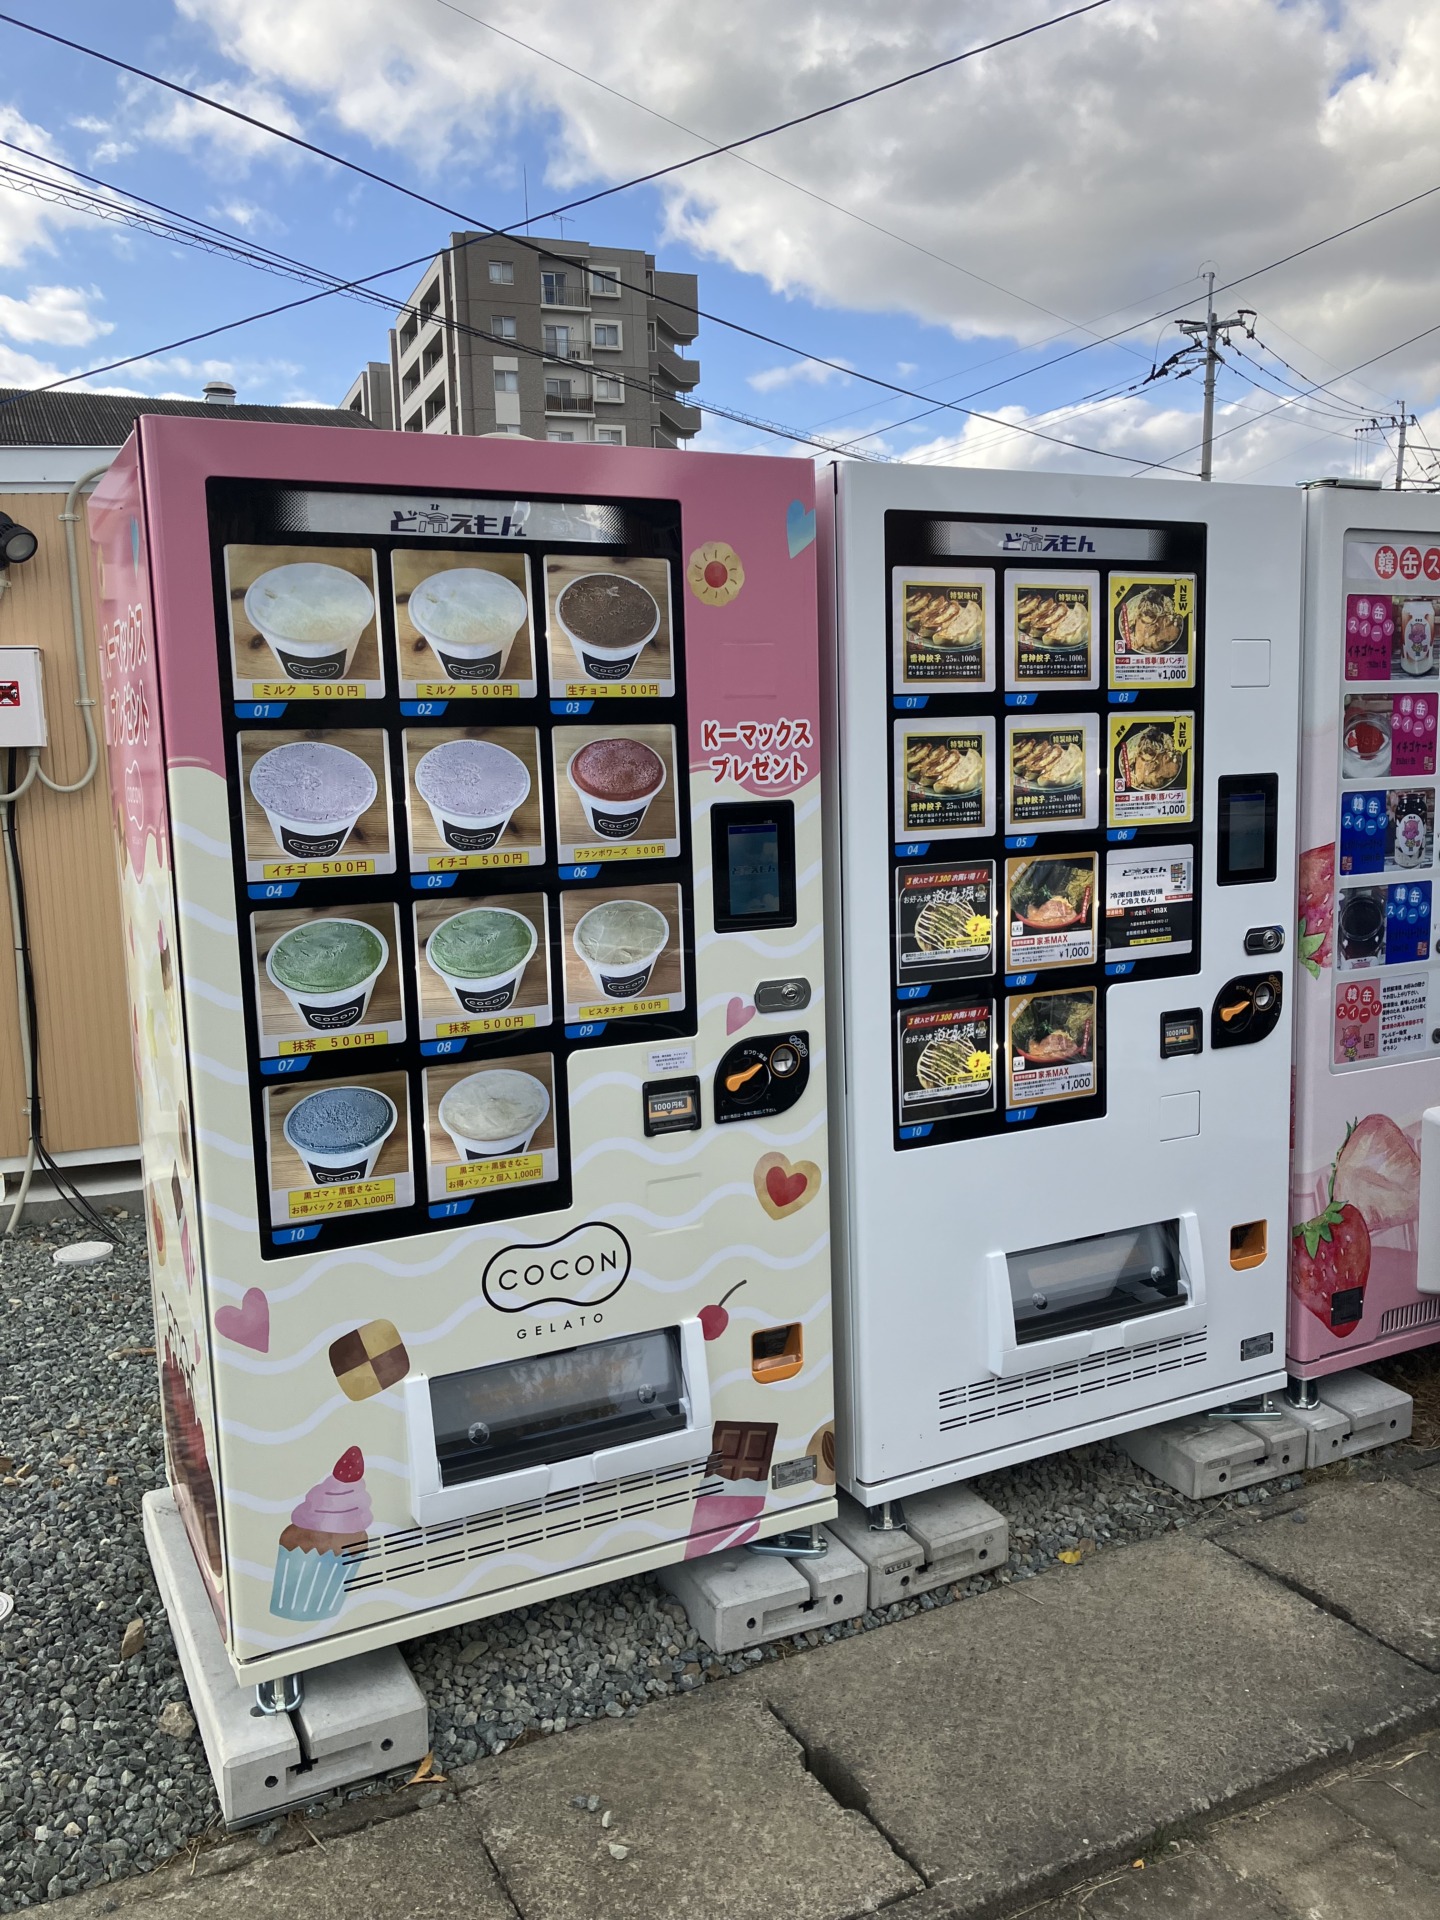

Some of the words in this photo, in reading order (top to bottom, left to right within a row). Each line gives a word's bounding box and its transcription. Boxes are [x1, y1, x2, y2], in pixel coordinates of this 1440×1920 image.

[1002, 532, 1096, 553] ど冷えもん
[1179, 585, 1188, 611] NEW
[1349, 620, 1393, 635] スイーツ
[292, 667, 335, 676] COCON
[453, 667, 490, 675] COCON
[593, 666, 628, 675] COCON
[1158, 669, 1187, 681] ¥1,000
[263, 685, 297, 696] ミルク
[312, 685, 358, 697] 500円
[426, 685, 456, 696] ミルク
[471, 684, 513, 696] 500円
[567, 685, 608, 696] 生チョコ
[620, 684, 659, 696] 500円
[906, 697, 918, 708] 01
[1016, 694, 1028, 705] 02
[1118, 692, 1129, 702] 03
[253, 704, 270, 717] 01
[416, 703, 433, 715] 02
[565, 702, 580, 713] 03
[1392, 716, 1434, 730] スイーツ
[1178, 721, 1187, 748] NEW
[711, 754, 806, 784] プレゼント
[1157, 804, 1186, 816] ¥1,000
[602, 821, 635, 830] COCON
[1343, 815, 1387, 831] スイーツ
[454, 835, 492, 844] COCON
[1116, 829, 1128, 840] 06
[293, 841, 335, 852] COCON
[1016, 837, 1028, 848] 05
[575, 848, 628, 859] フランボワーズ
[636, 846, 664, 855] 500円
[907, 844, 919, 855] 04
[436, 857, 469, 868] イチゴ
[481, 854, 523, 865] 500円
[272, 863, 308, 876] イチゴ
[322, 861, 368, 874] 500円
[573, 866, 587, 878] 06
[427, 875, 442, 887] 05
[266, 885, 283, 897] 04
[1110, 888, 1164, 899] 冷凍自動販売機
[1386, 905, 1428, 919] スイーツ
[1036, 934, 1068, 946] 家系MAX
[1059, 946, 1089, 959] ¥1,000
[1116, 963, 1126, 974] 09
[611, 981, 643, 990] COCON
[1016, 974, 1027, 986] 08
[908, 987, 920, 998] 07
[470, 996, 506, 1006] COCON
[588, 1005, 625, 1016] ピスタチオ
[633, 1001, 662, 1011] 600円
[1338, 1003, 1380, 1018] スイーツ
[315, 1011, 355, 1021] COCON
[449, 1021, 471, 1034] 抹茶
[483, 1016, 524, 1030] 500円
[579, 1024, 594, 1036] 09
[292, 1040, 317, 1053] 抹茶
[330, 1033, 375, 1048] 500円
[436, 1041, 452, 1053] 08
[277, 1059, 295, 1072] 07
[1037, 1067, 1070, 1079] 家系MAX
[1060, 1077, 1091, 1091] ¥1,000
[653, 1100, 685, 1112] 1000円札
[1016, 1109, 1027, 1120] 11
[911, 1126, 922, 1138] 10
[514, 1168, 542, 1181] 1,000円
[364, 1193, 394, 1206] 1,000円
[445, 1203, 458, 1215] 11
[290, 1228, 305, 1241] 10
[498, 1249, 618, 1291] COCON
[516, 1312, 604, 1340] GELATO
